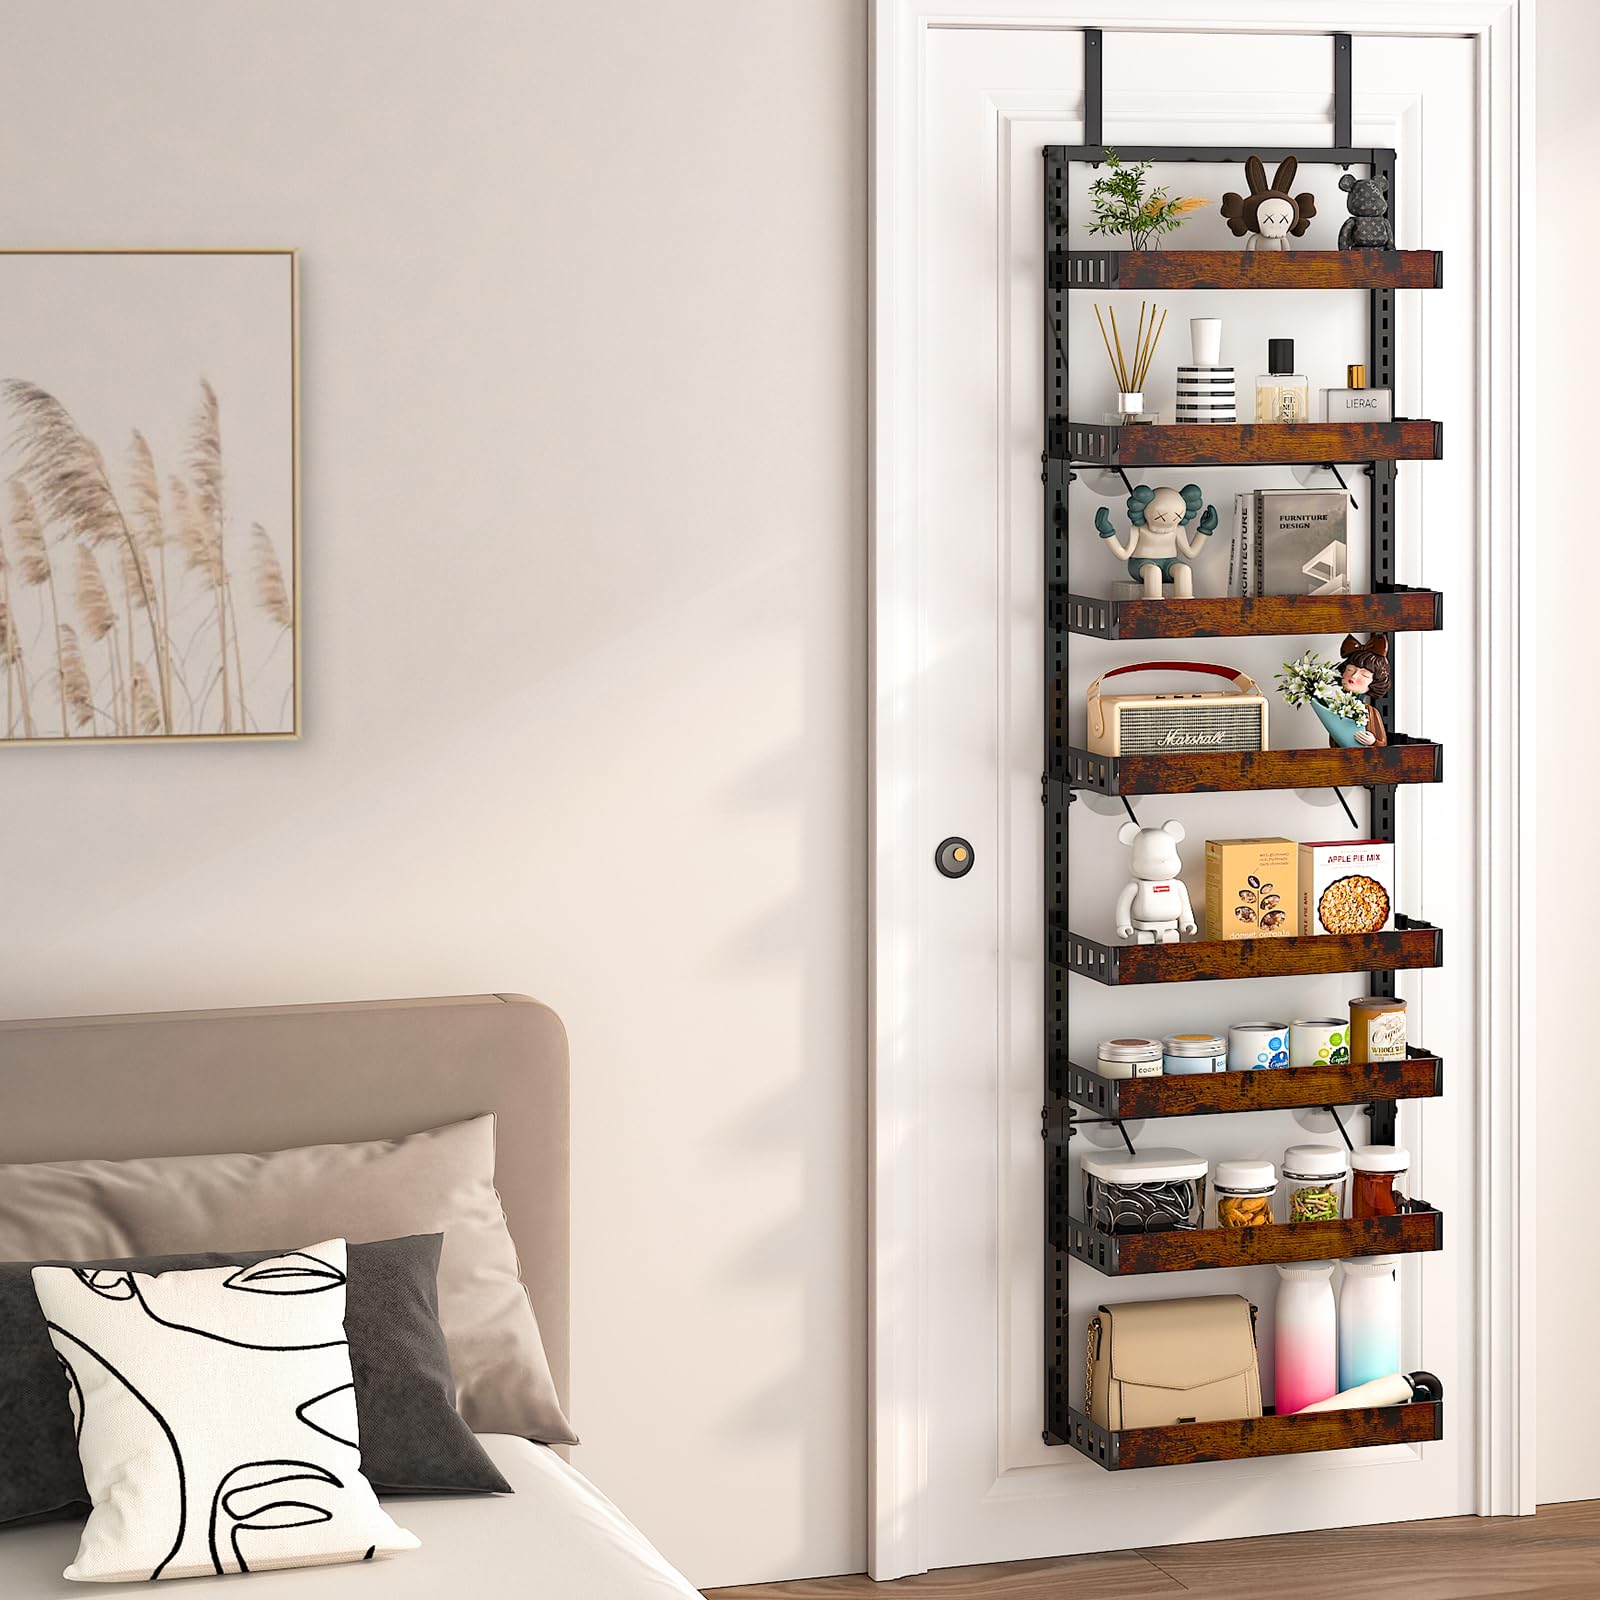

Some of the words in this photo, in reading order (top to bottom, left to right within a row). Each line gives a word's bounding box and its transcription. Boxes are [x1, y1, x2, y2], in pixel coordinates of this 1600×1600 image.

[1345, 398, 1377, 408] LIERAC
[1157, 728, 1226, 746] Marshall
[1327, 855, 1351, 863] APPLE
[1353, 854, 1365, 862] PIE
[1366, 853, 1381, 862] MIX
